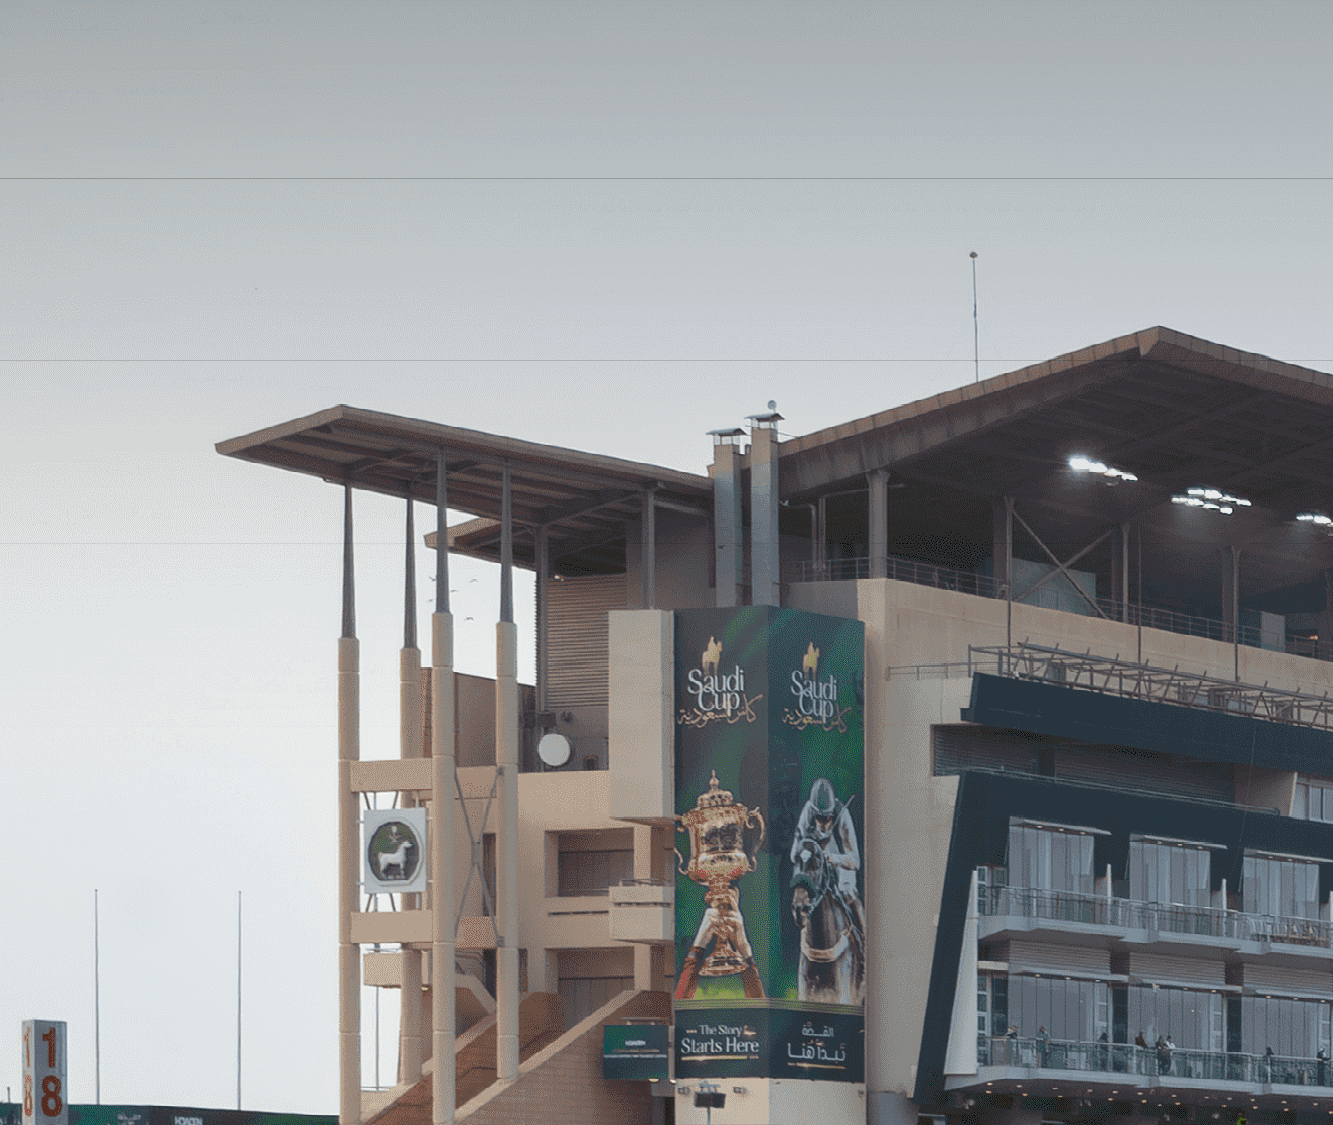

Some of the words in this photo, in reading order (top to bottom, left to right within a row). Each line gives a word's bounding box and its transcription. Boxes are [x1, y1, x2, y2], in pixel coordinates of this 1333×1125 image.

[687, 665, 745, 694] Saudi
[790, 670, 837, 700] Saudi
[698, 690, 741, 717] Cup
[799, 694, 834, 724] Cup
[681, 1037, 723, 1053] Starts
[726, 1037, 760, 1053] Here
[699, 1025, 717, 1035] The
[718, 1025, 743, 1037] Story
